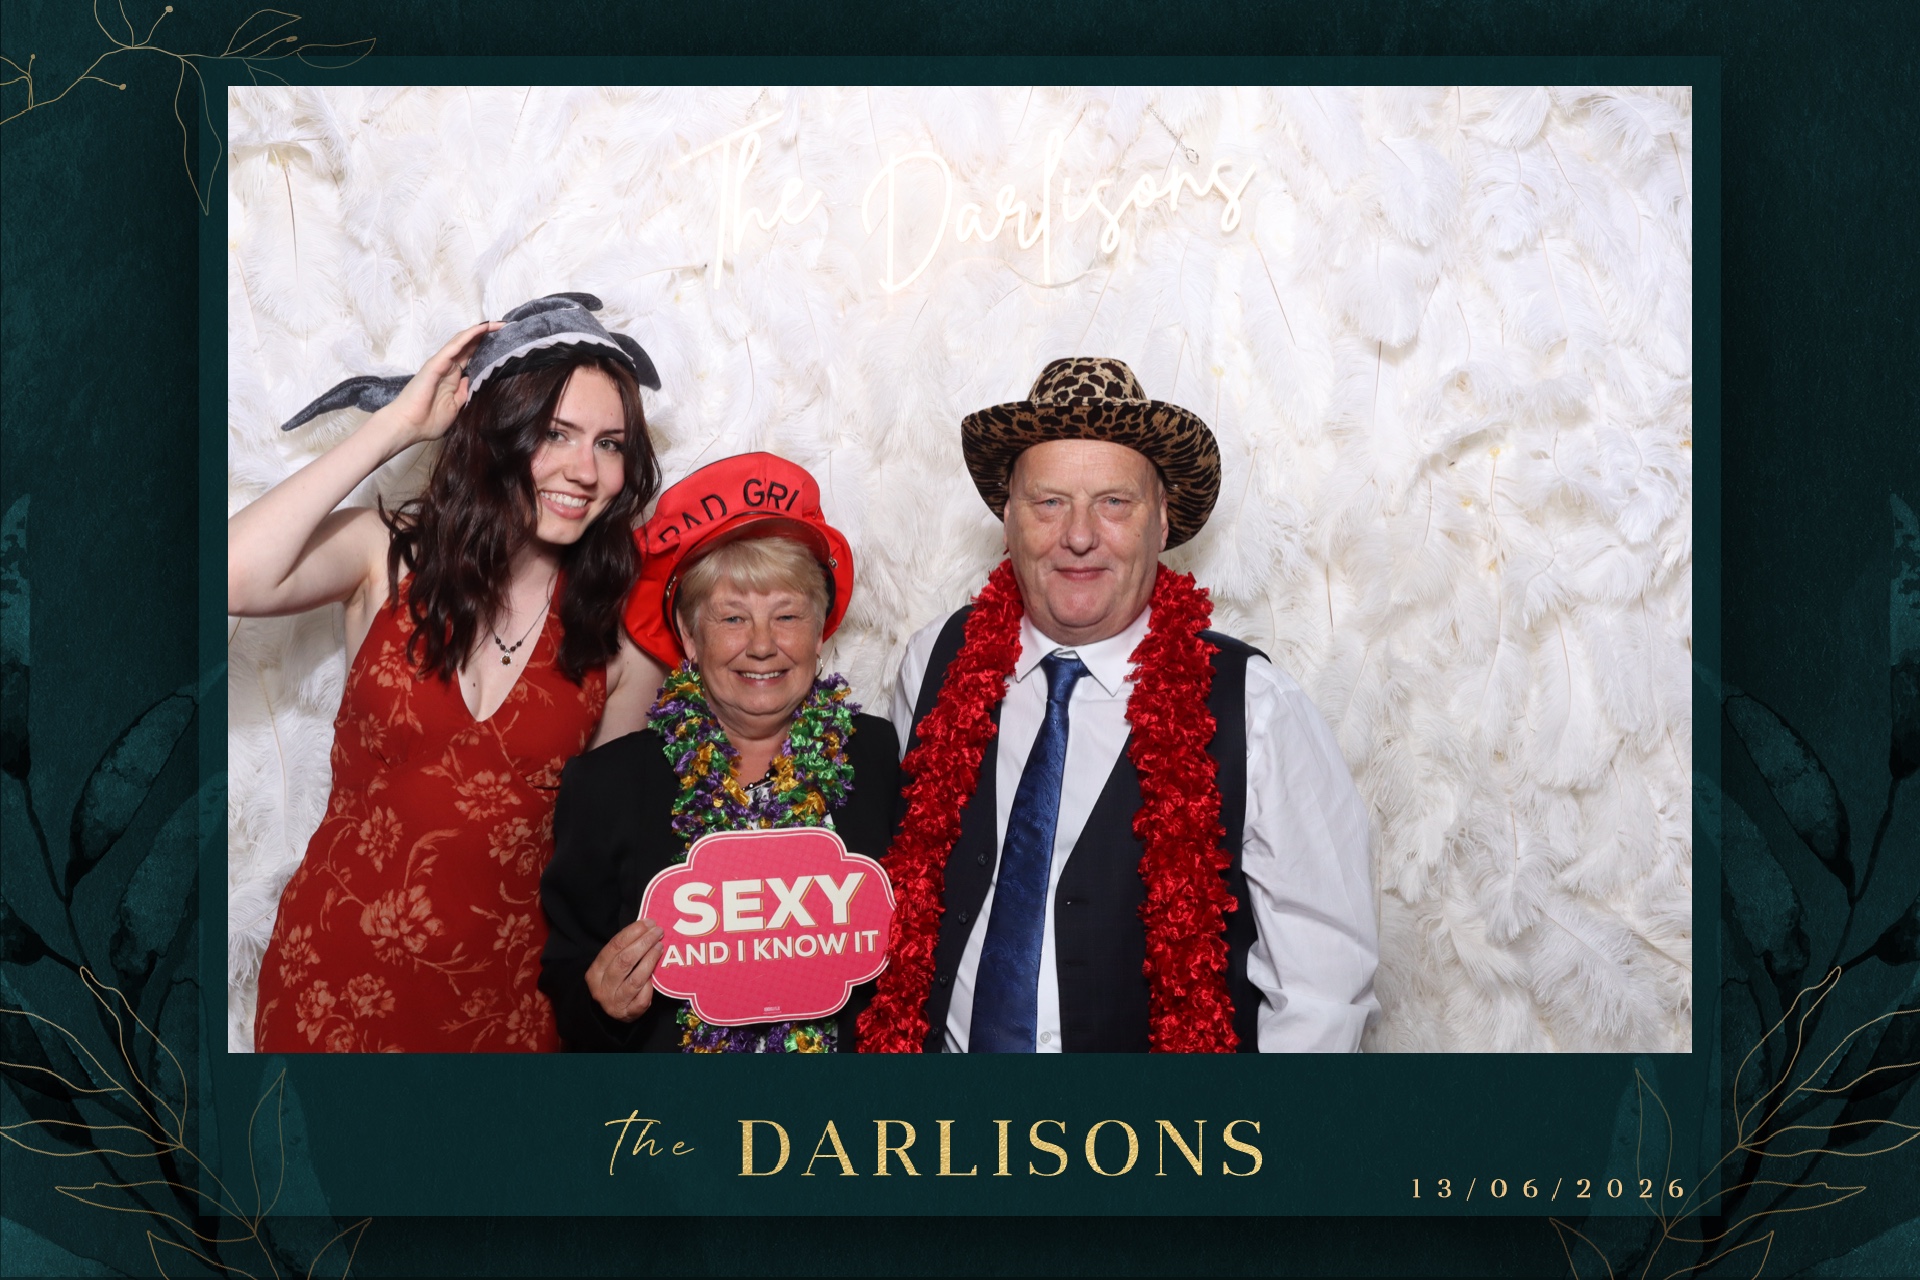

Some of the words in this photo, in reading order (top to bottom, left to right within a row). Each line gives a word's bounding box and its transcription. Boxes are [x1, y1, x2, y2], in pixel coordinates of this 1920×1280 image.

[670, 109, 825, 290] The
[861, 128, 1257, 293] Darlisons
[672, 872, 867, 937] SEXY
[661, 941, 730, 969] AND
[737, 939, 747, 962] I
[753, 932, 849, 962] KNOW
[854, 929, 881, 954] IT
